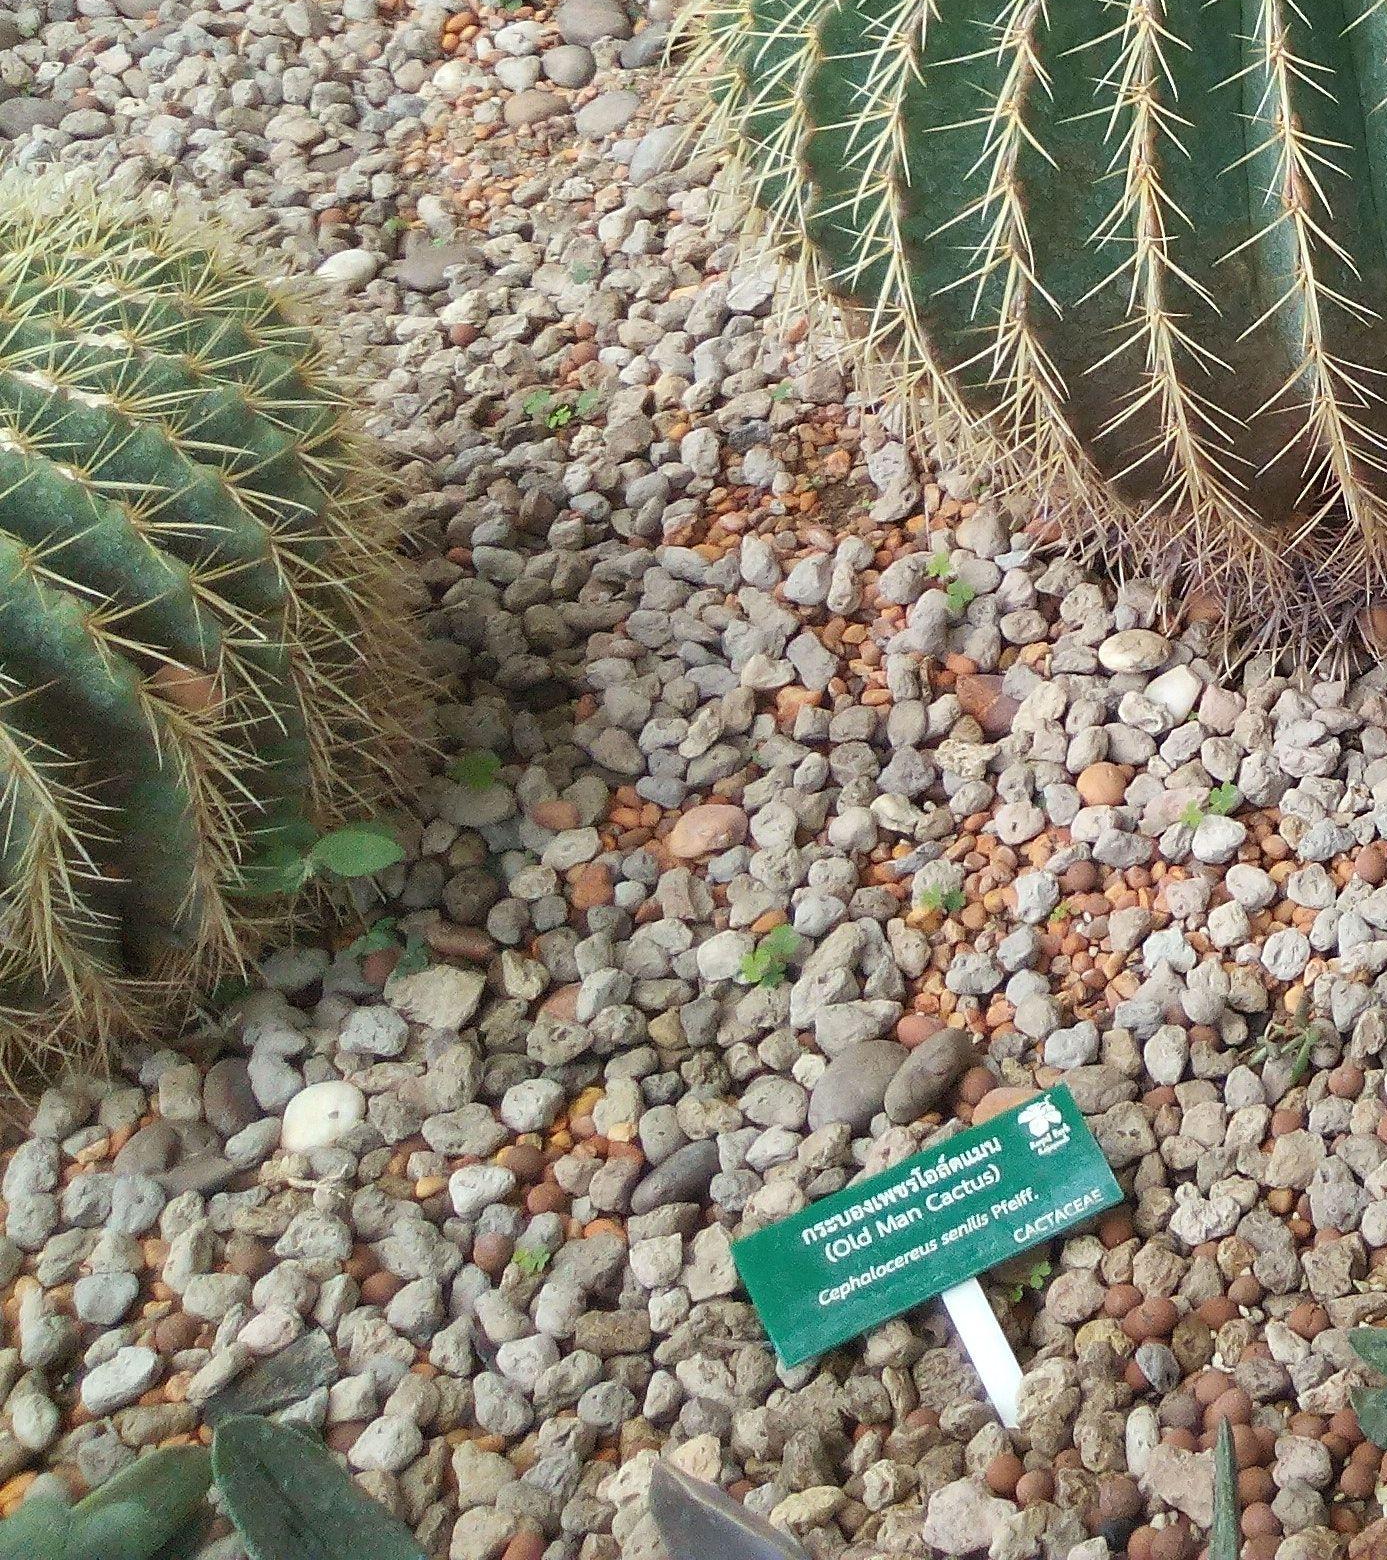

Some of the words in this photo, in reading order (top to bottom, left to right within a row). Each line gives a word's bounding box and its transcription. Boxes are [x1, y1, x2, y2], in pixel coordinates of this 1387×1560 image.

[818, 1238, 939, 1306] Cephalocereus
[940, 1213, 990, 1247] senilis
[990, 1186, 1040, 1220] Pfeiff.
[825, 1226, 873, 1263] (Old
[875, 1206, 924, 1238] Man
[925, 1163, 1001, 1212] Cactus)
[1013, 1187, 1105, 1244] CACTACEAE
